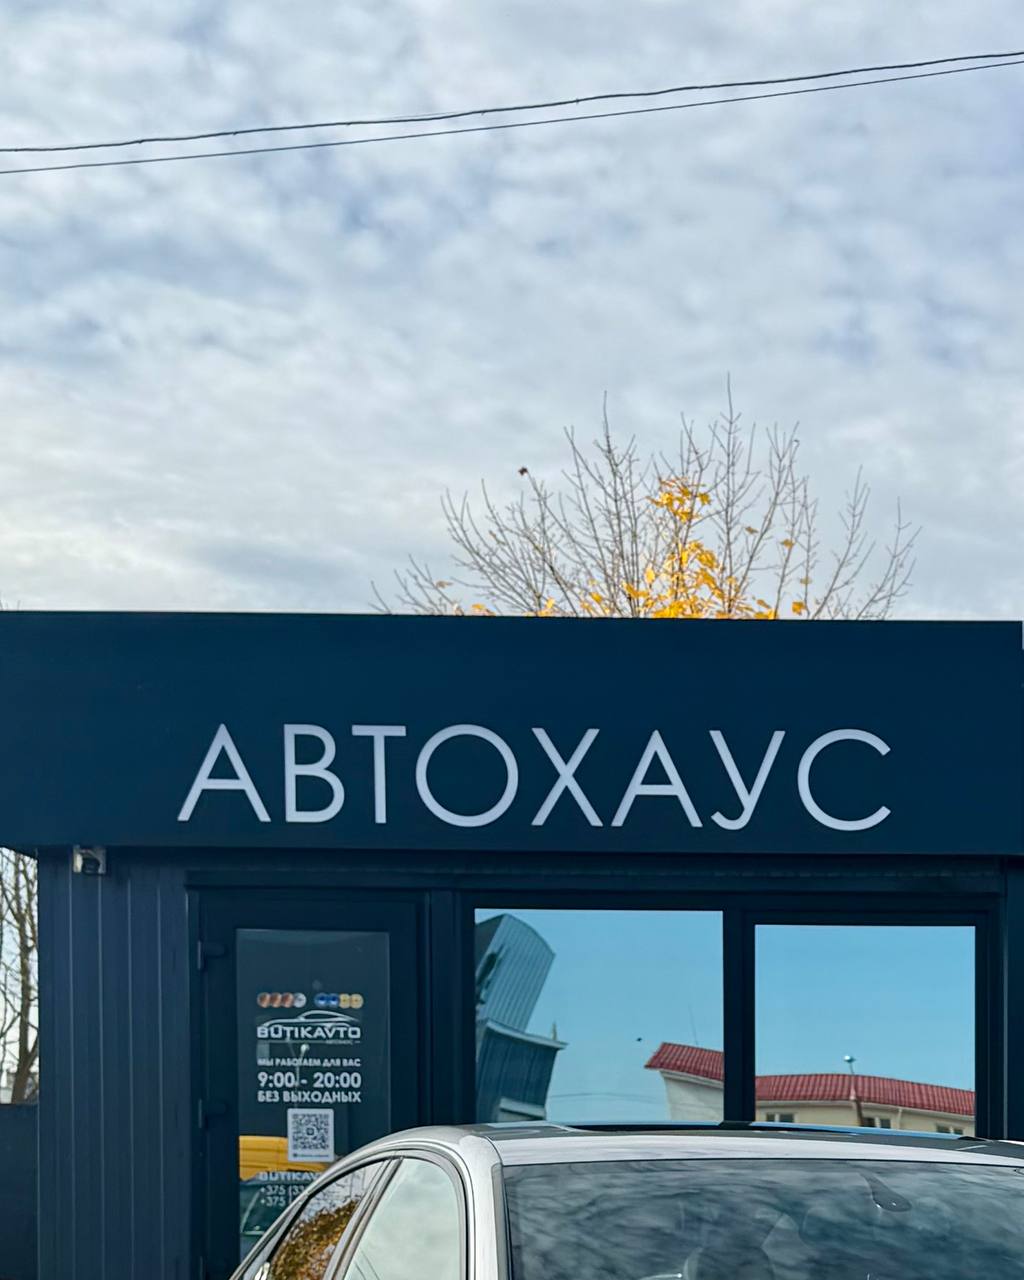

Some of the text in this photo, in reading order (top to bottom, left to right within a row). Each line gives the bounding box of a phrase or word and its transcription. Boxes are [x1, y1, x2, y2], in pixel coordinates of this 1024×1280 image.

[178, 723, 891, 832] АВТОХАУС
[257, 1026, 361, 1038] BUTIKAVTO
[343, 1058, 361, 1067] ВАС
[257, 1071, 296, 1088] 9:00
[313, 1071, 362, 1088] 20:00
[257, 1090, 362, 1103] БЕЗ ВЫХОДНЫХ
